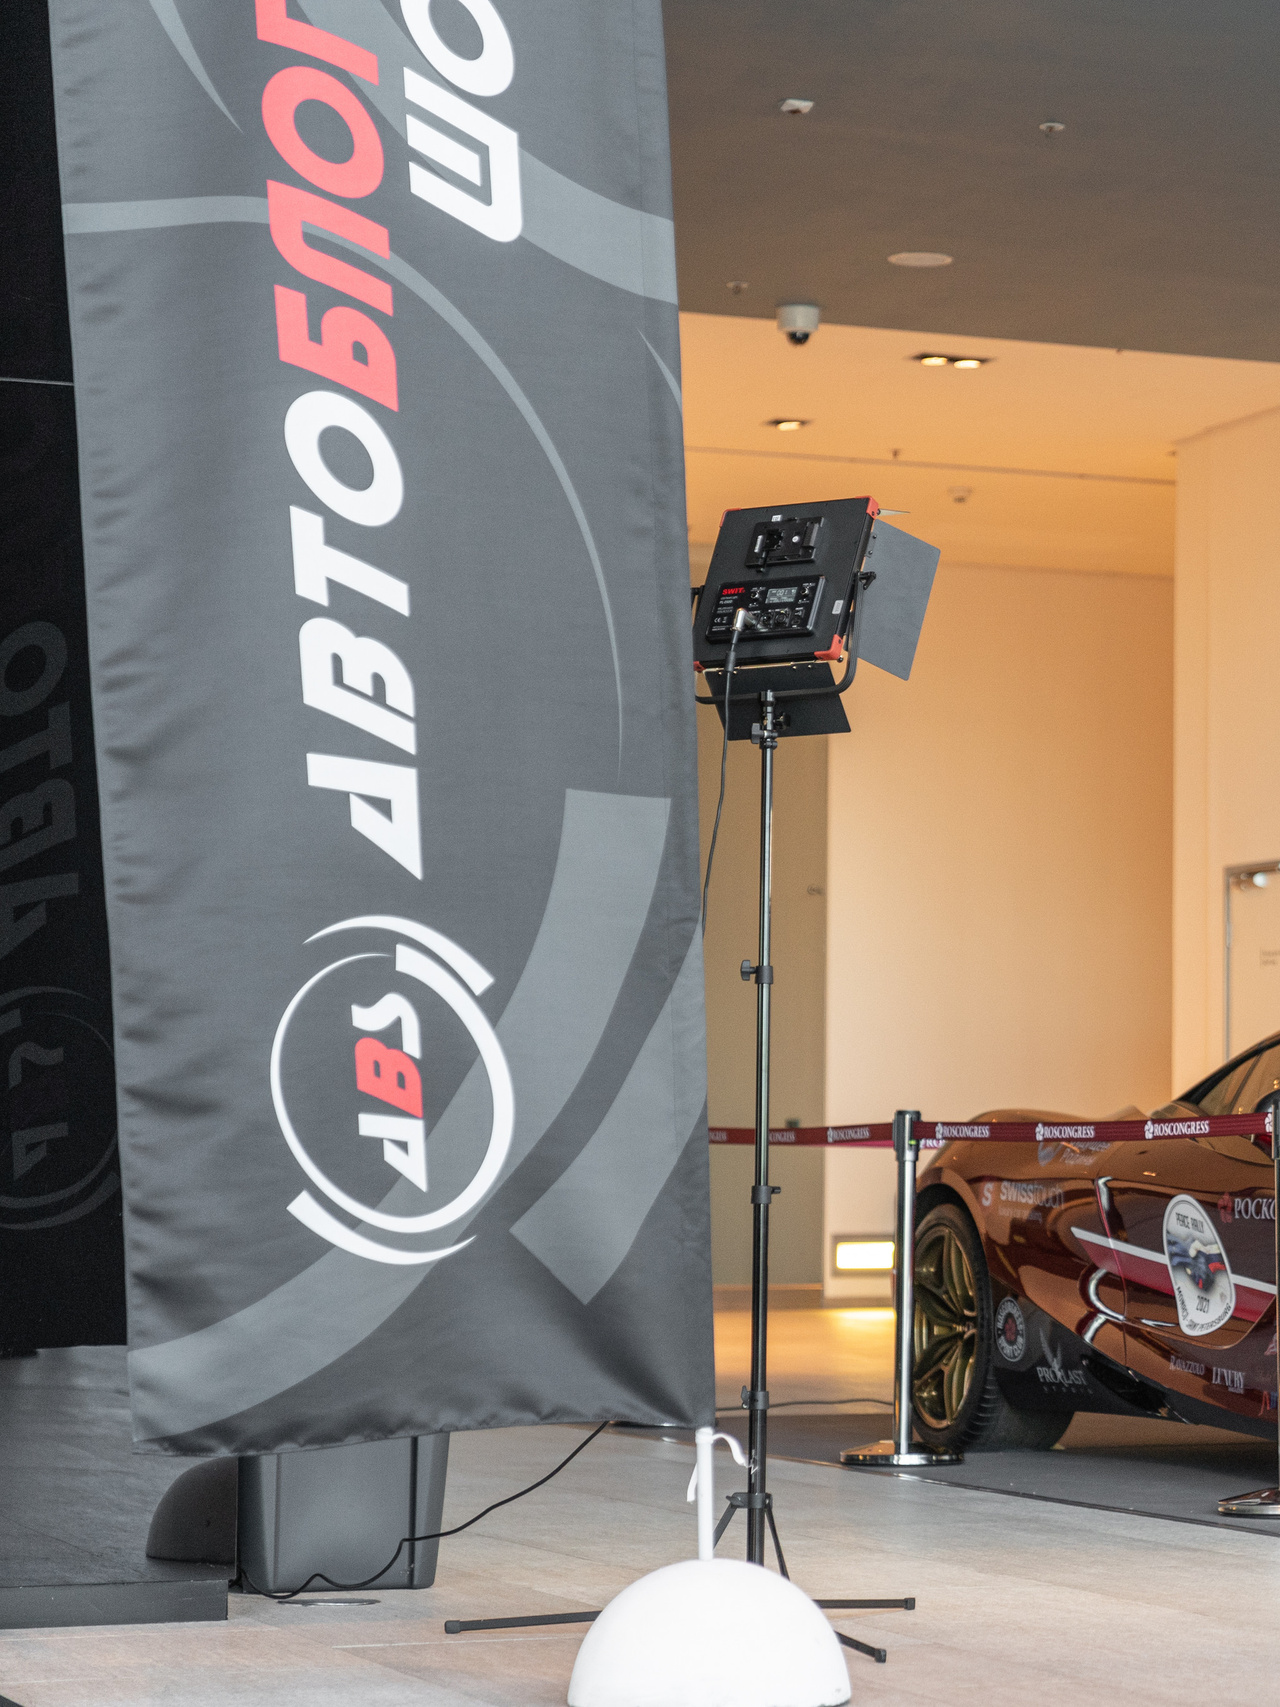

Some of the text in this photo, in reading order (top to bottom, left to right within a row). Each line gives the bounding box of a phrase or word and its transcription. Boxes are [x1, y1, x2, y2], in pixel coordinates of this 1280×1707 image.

[721, 586, 743, 596] SWIT
[351, 991, 428, 1192] ABS
[943, 1125, 990, 1138] ROSCONGRESS
[1043, 1125, 1095, 1139] ROSCONGRESS
[1153, 1120, 1210, 1136] ROSCONGRESS
[1196, 1295, 1210, 1313] 2021
